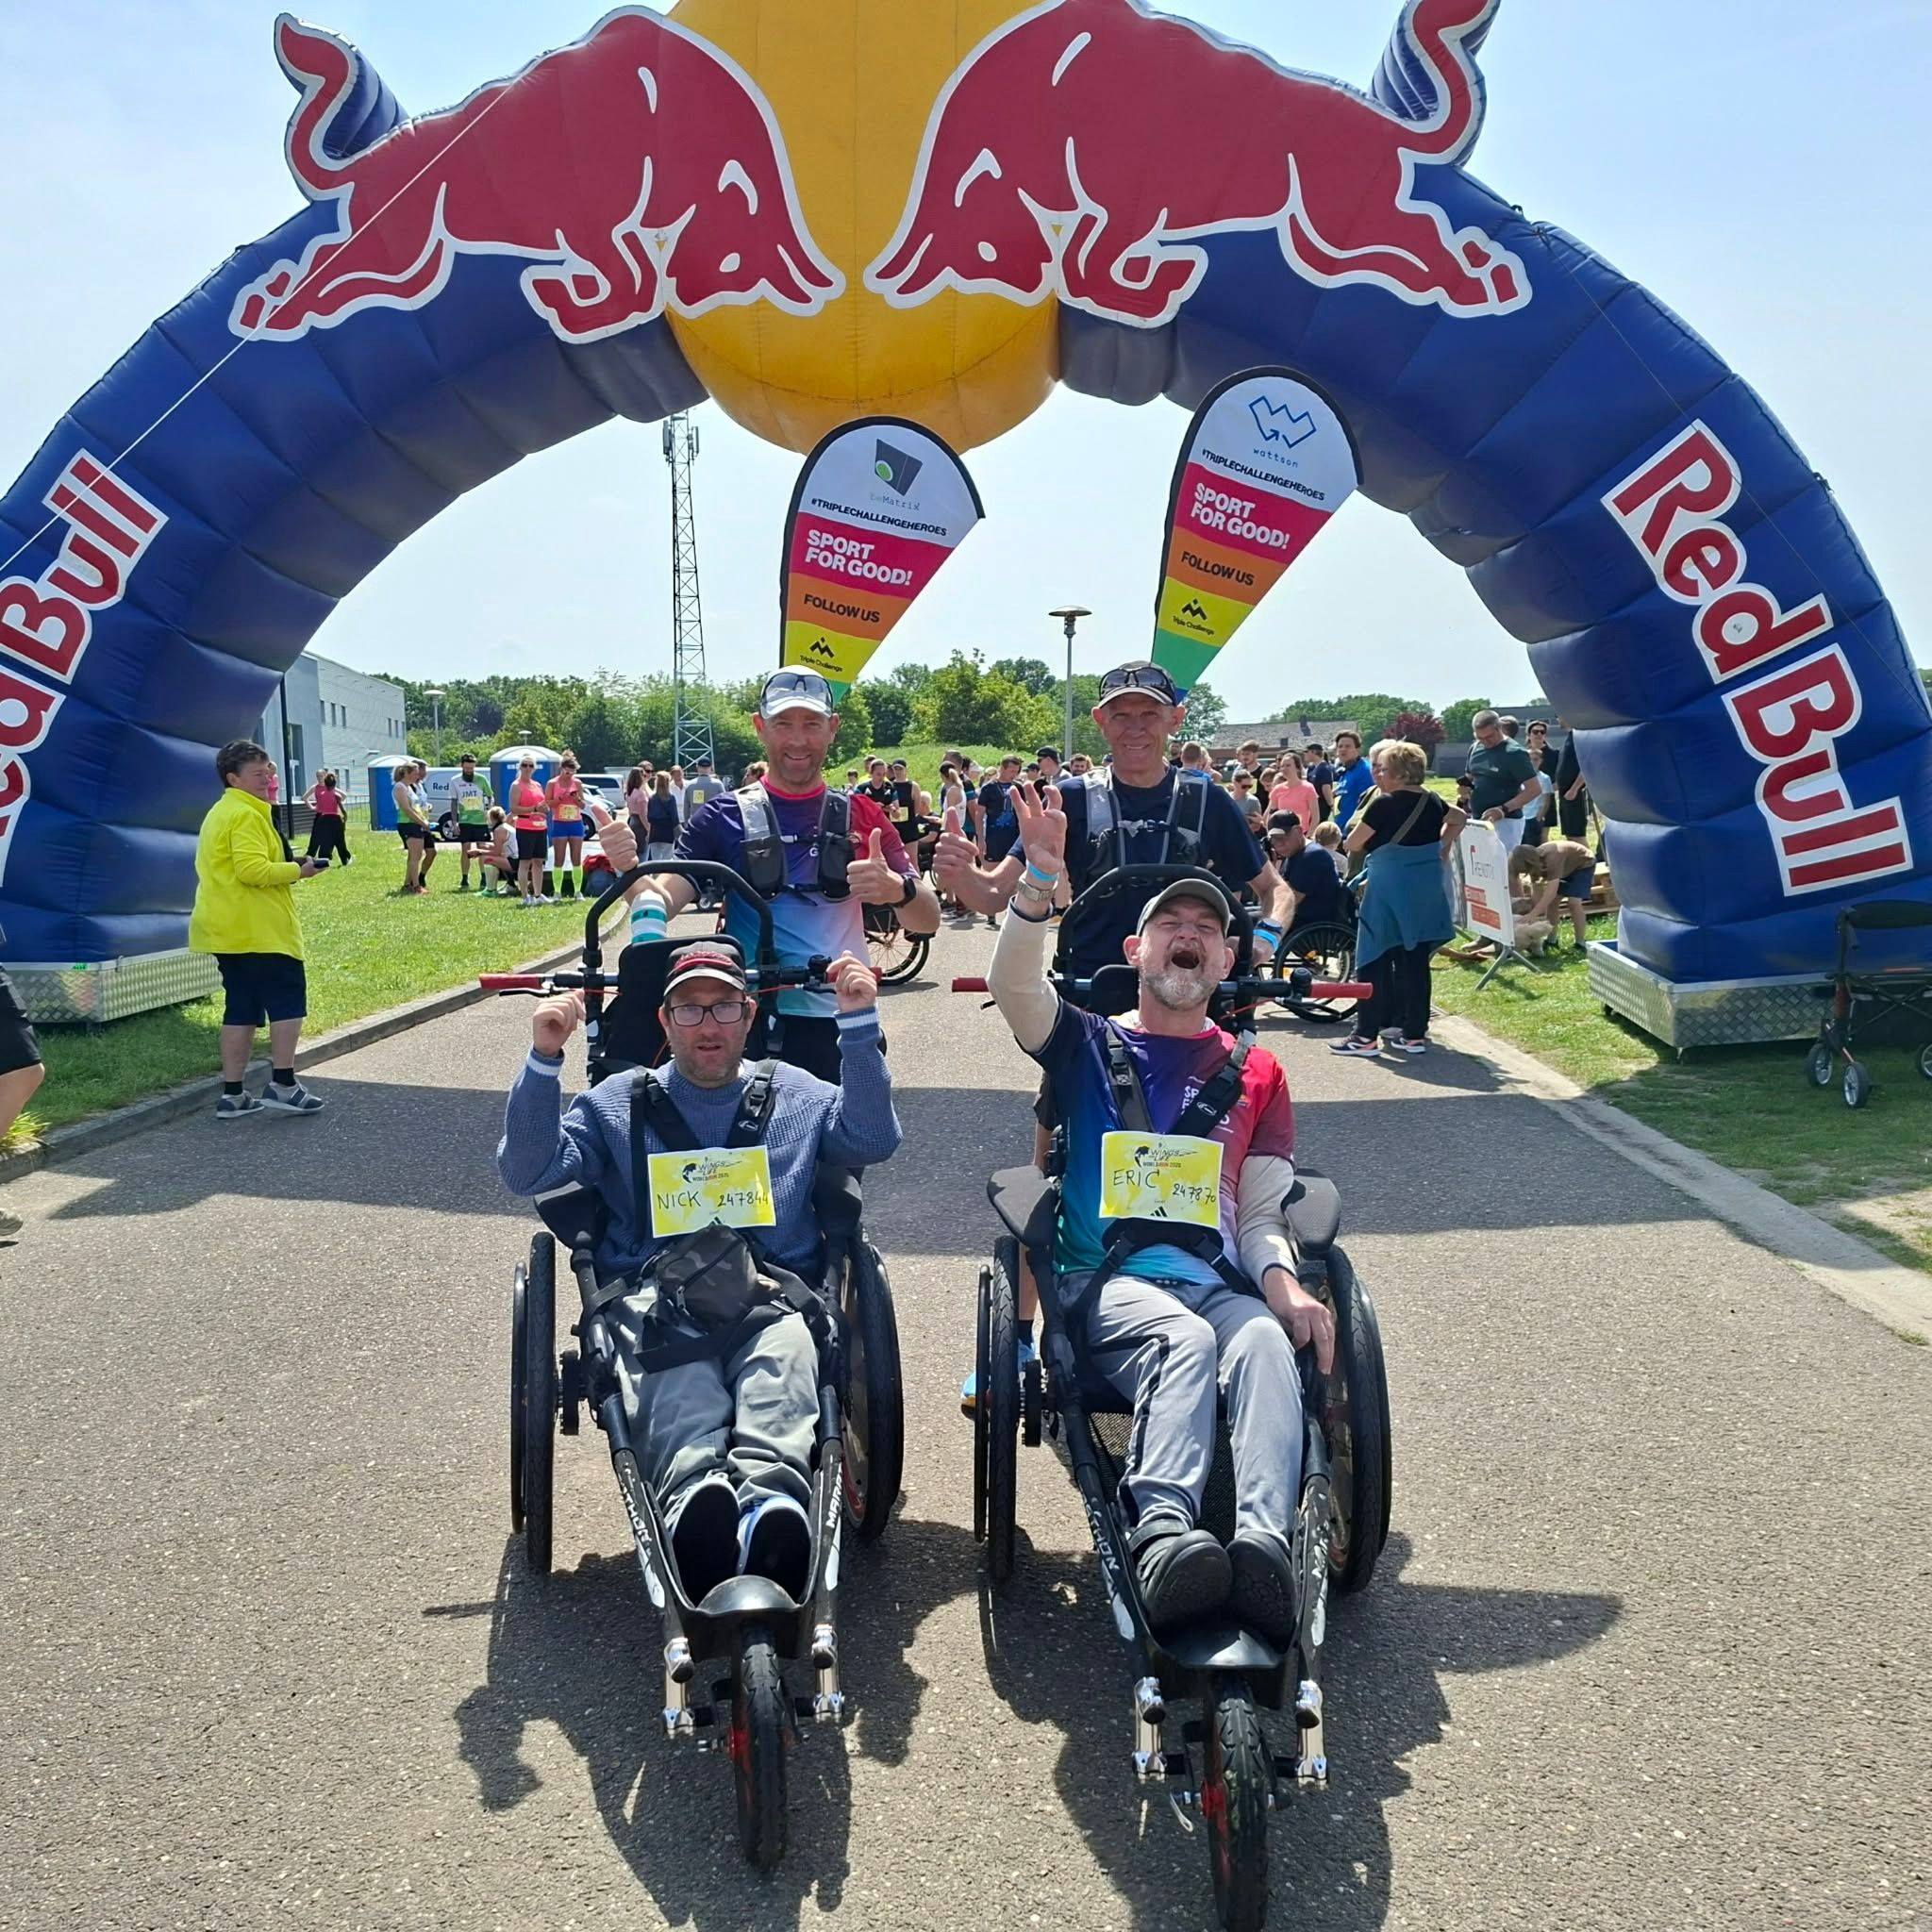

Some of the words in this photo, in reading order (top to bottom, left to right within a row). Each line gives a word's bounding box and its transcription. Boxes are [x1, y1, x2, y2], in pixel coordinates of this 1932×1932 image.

[1253, 446, 1299, 469] wattson
[1202, 448, 1324, 502] #TRIPLECHALLENGEHEROES
[811, 497, 947, 537] #TRIPLECHALLENGEHEROES
[1193, 482, 1256, 519] SPORT
[807, 528, 874, 559] SPORT
[1191, 505, 1225, 531] FOR
[1226, 519, 1291, 550] GOOD!
[0, 453, 163, 680] Bull
[805, 548, 846, 573] FOR
[847, 559, 913, 586] GOOD!
[1180, 551, 1237, 581] FOLLOW
[1236, 568, 1255, 587] US
[804, 593, 860, 619] FOLLOW
[861, 609, 881, 624] US
[1606, 425, 1830, 679] Red
[1726, 648, 1909, 891] Bull
[432, 782, 450, 791] Red
[1113, 1168, 1160, 1189] ERIC
[1172, 1183, 1217, 1205] 247870
[657, 1191, 702, 1209] NICK
[717, 1191, 769, 1208] 247844
